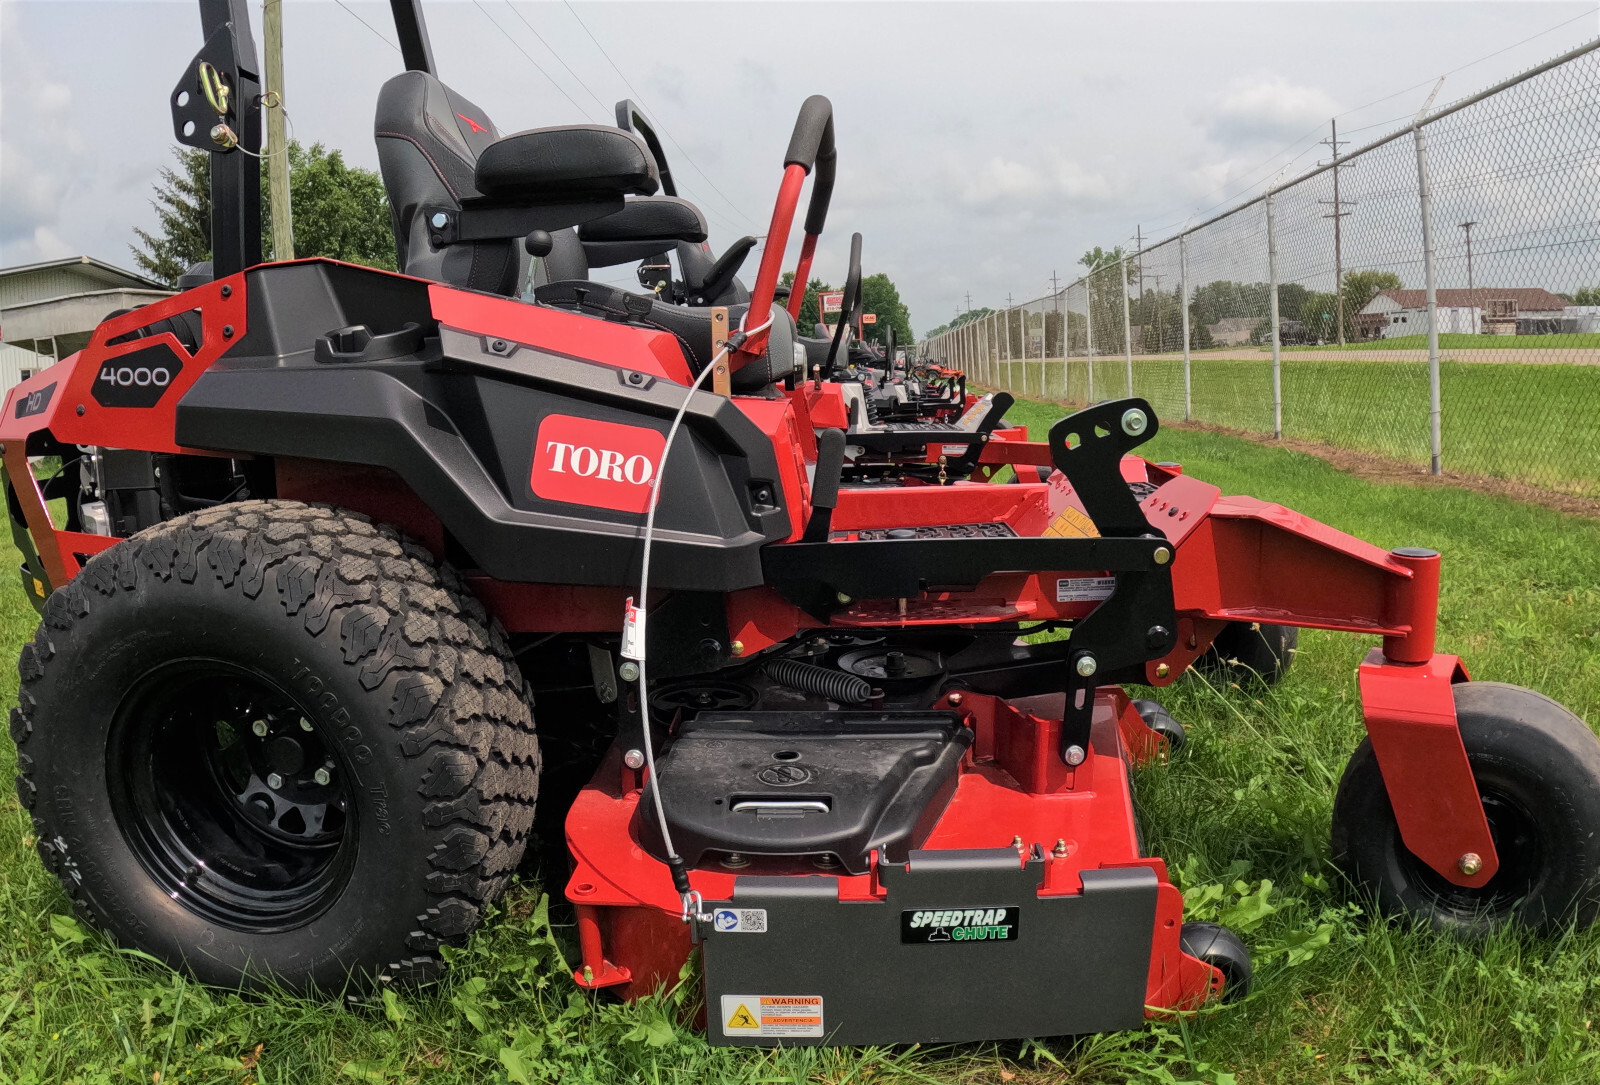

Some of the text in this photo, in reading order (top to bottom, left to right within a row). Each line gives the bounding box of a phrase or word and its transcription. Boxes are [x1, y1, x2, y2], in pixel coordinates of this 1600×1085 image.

[100, 367, 170, 386] 4000
[26, 393, 42, 413] HD
[546, 441, 653, 485] TORO
[910, 908, 1007, 928] SPEEDTRAP
[952, 926, 1009, 941] CHUTE
